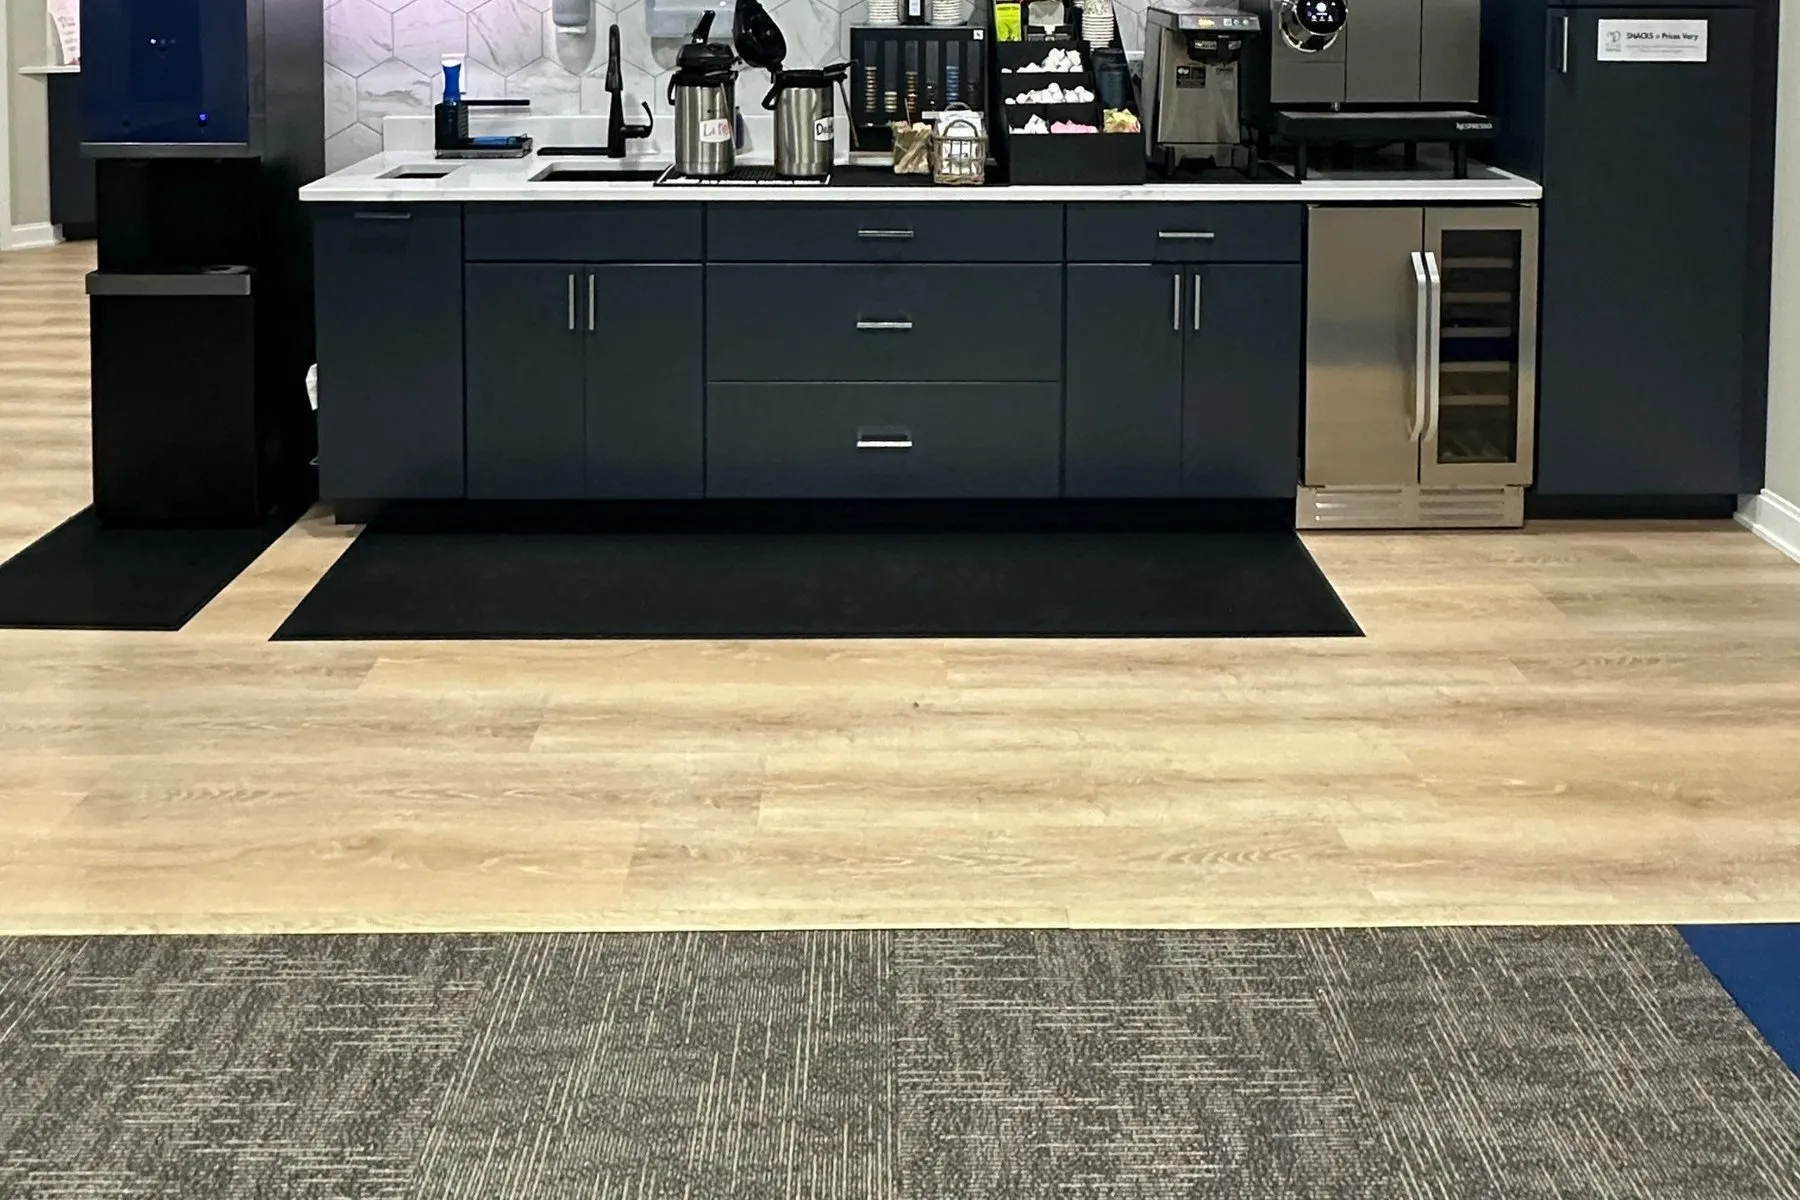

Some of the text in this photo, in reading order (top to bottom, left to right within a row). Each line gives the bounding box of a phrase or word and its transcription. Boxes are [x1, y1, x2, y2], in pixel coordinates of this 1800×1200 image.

[1626, 32, 1654, 40] SNACKS
[1662, 32, 1681, 40] Prices
[1682, 32, 1699, 41] Vary
